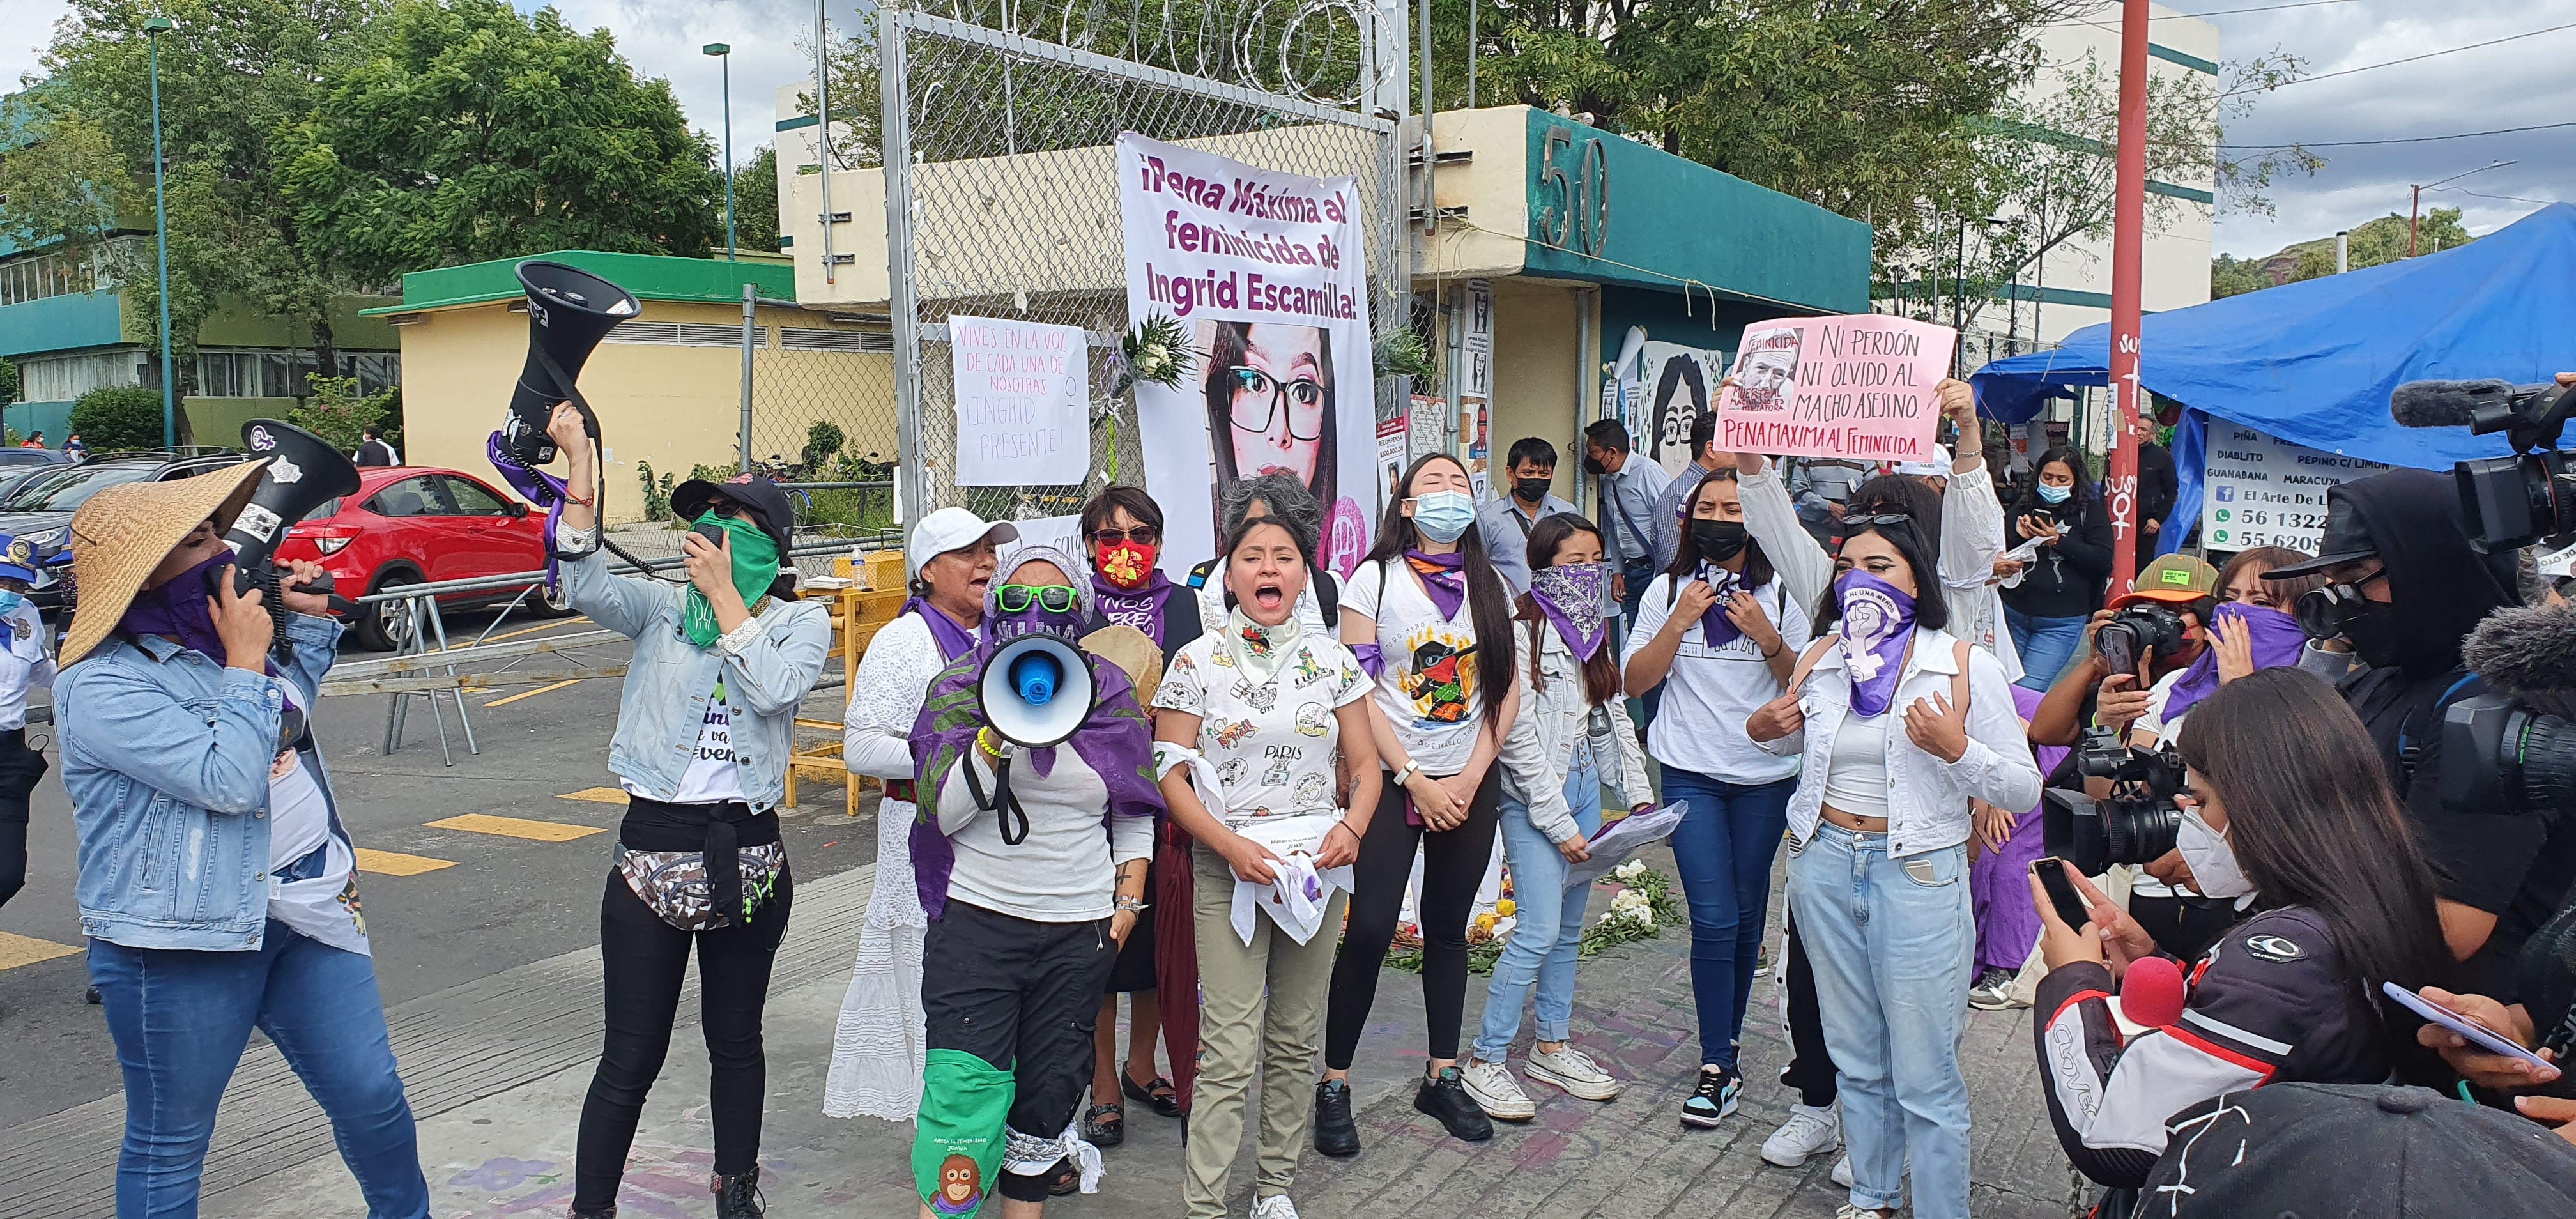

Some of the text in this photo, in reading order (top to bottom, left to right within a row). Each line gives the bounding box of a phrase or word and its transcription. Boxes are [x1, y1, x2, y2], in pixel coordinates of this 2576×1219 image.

[1140, 153, 1347, 224] ¡Pena Máxima al
[1542, 125, 1611, 256] 50
[1165, 210, 1339, 270] feminicida de
[1146, 262, 1357, 320] Ingrid Escamilla!
[958, 325, 1066, 352] VIVES EN LA VOZ
[1748, 334, 1799, 351] FEMINICIDA
[1820, 325, 1919, 358] NI PERDÓN
[2119, 334, 2140, 353] SU
[966, 353, 1064, 374] DE CADA UNA DE
[1800, 362, 1917, 387] NI OLVIDO AL
[990, 376, 1047, 395] NOSOTRAS
[1733, 386, 1781, 399] MUERTE AL
[966, 396, 1036, 426] ¡INGRID
[1793, 392, 1919, 422] MACHO ASESINO.
[980, 427, 1063, 461] PRESENTE!
[1723, 419, 1922, 456] PENA MAXIMA AL FEMINICIDA.
[2234, 430, 2257, 441] PIÑA
[2217, 450, 2264, 462] DIABLITO
[2297, 454, 2336, 467] PEPINO
[2340, 458, 2352, 468] C/
[2207, 468, 2268, 481] GUANABANA
[2244, 490, 2257, 500] El
[2261, 491, 2290, 503] Arte
[2295, 494, 2313, 505] De
[2241, 510, 2267, 525] 56
[2240, 532, 2265, 547] 55
[1876, 594, 1894, 613] MENOS
[1385, 633, 1402, 649] TODO
[1260, 705, 1275, 714] CITY
[712, 731, 730, 744] va
[1264, 744, 1303, 760] PARIS
[1296, 776, 1310, 790] MADE
